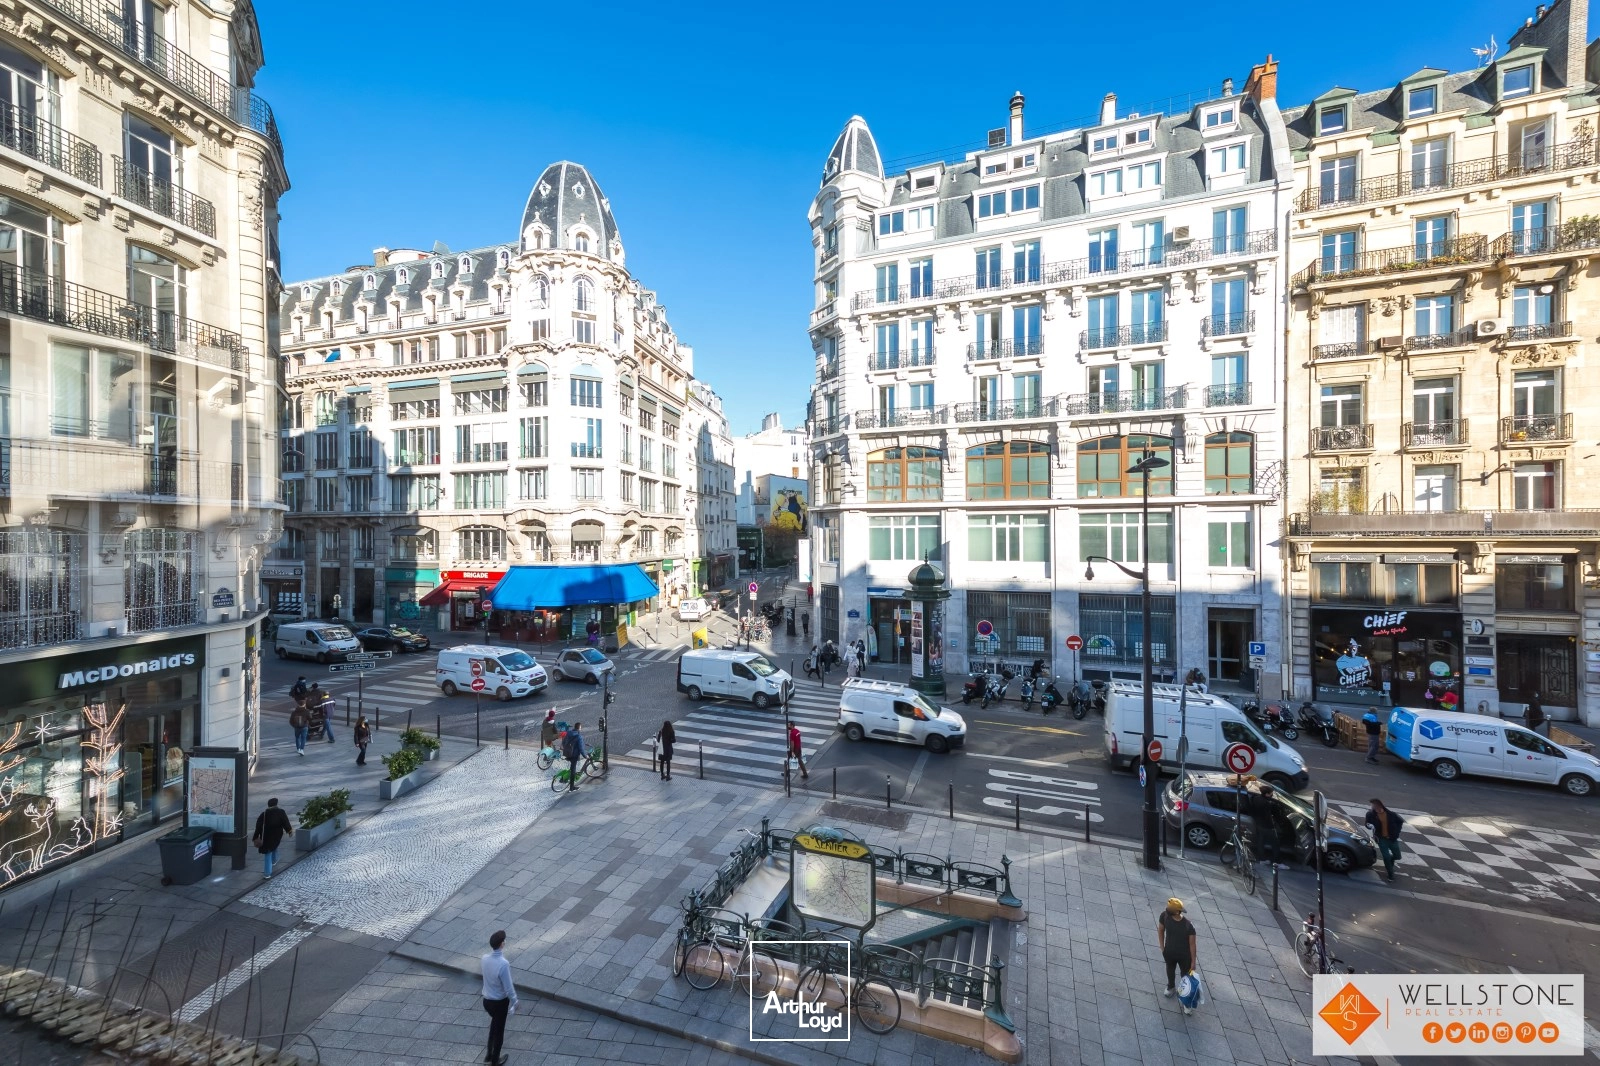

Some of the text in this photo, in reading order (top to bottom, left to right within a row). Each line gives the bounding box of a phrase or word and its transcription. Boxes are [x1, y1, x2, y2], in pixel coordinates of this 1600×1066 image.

[462, 571, 489, 579] BRIGADE
[58, 653, 195, 689] McDonald's
[1446, 725, 1499, 738] chronopost
